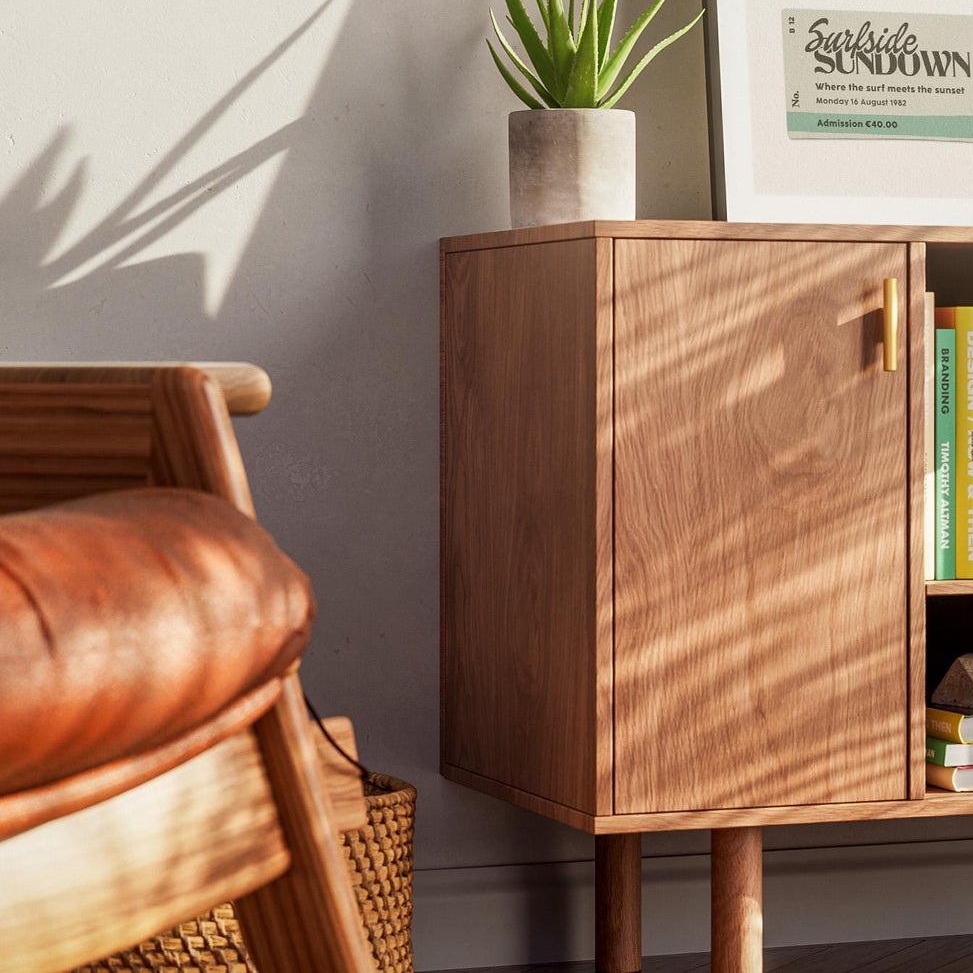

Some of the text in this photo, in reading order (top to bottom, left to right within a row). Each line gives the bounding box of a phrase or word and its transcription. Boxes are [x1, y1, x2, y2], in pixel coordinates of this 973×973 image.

[805, 17, 919, 59] Surfside
[814, 49, 971, 78] SUNDOWN
[815, 83, 846, 91] Where
[849, 83, 863, 91] the
[866, 84, 885, 92] surf
[918, 85, 932, 93] the
[816, 97, 849, 105] Monday
[861, 99, 888, 107] August
[817, 119, 863, 128] Admission
[941, 441, 950, 549] TIMOTHY ALTMAN
[931, 720, 951, 733] THEN
